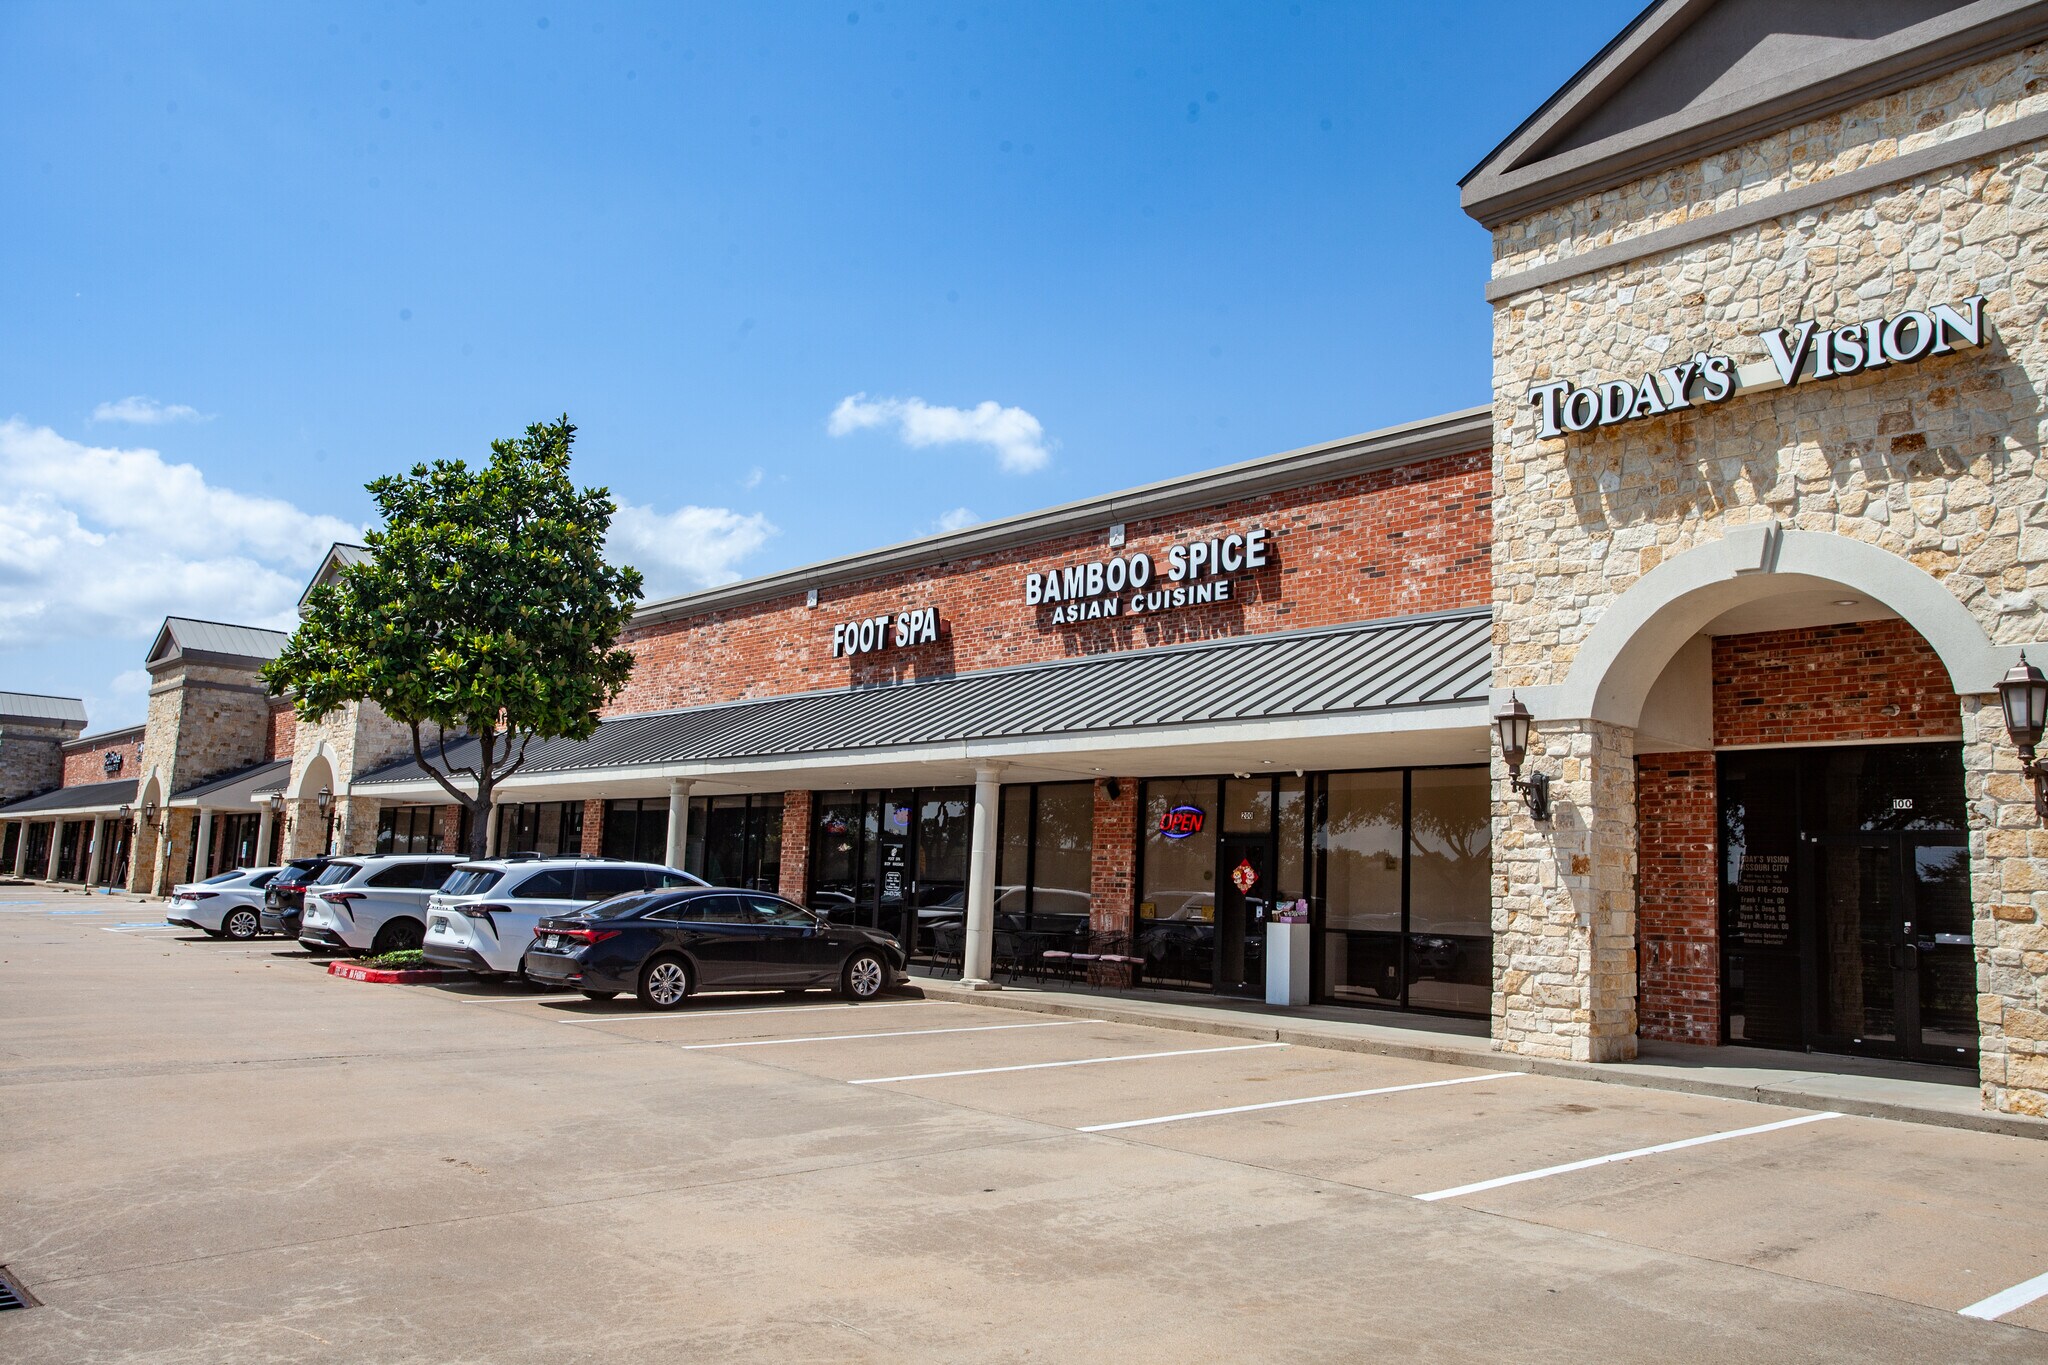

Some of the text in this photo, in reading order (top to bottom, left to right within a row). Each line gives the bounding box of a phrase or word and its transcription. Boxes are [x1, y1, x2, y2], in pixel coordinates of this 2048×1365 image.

[1528, 295, 1986, 440] TODAY'S VISION
[1026, 528, 1270, 606] BAMBOO SPICE
[1051, 580, 1233, 625] ASIAN CUISINE
[833, 607, 940, 658] FOOT SPA
[1159, 813, 1203, 831] OPEN
[1893, 799, 1912, 809] 100
[1772, 864, 1788, 872] CITY
